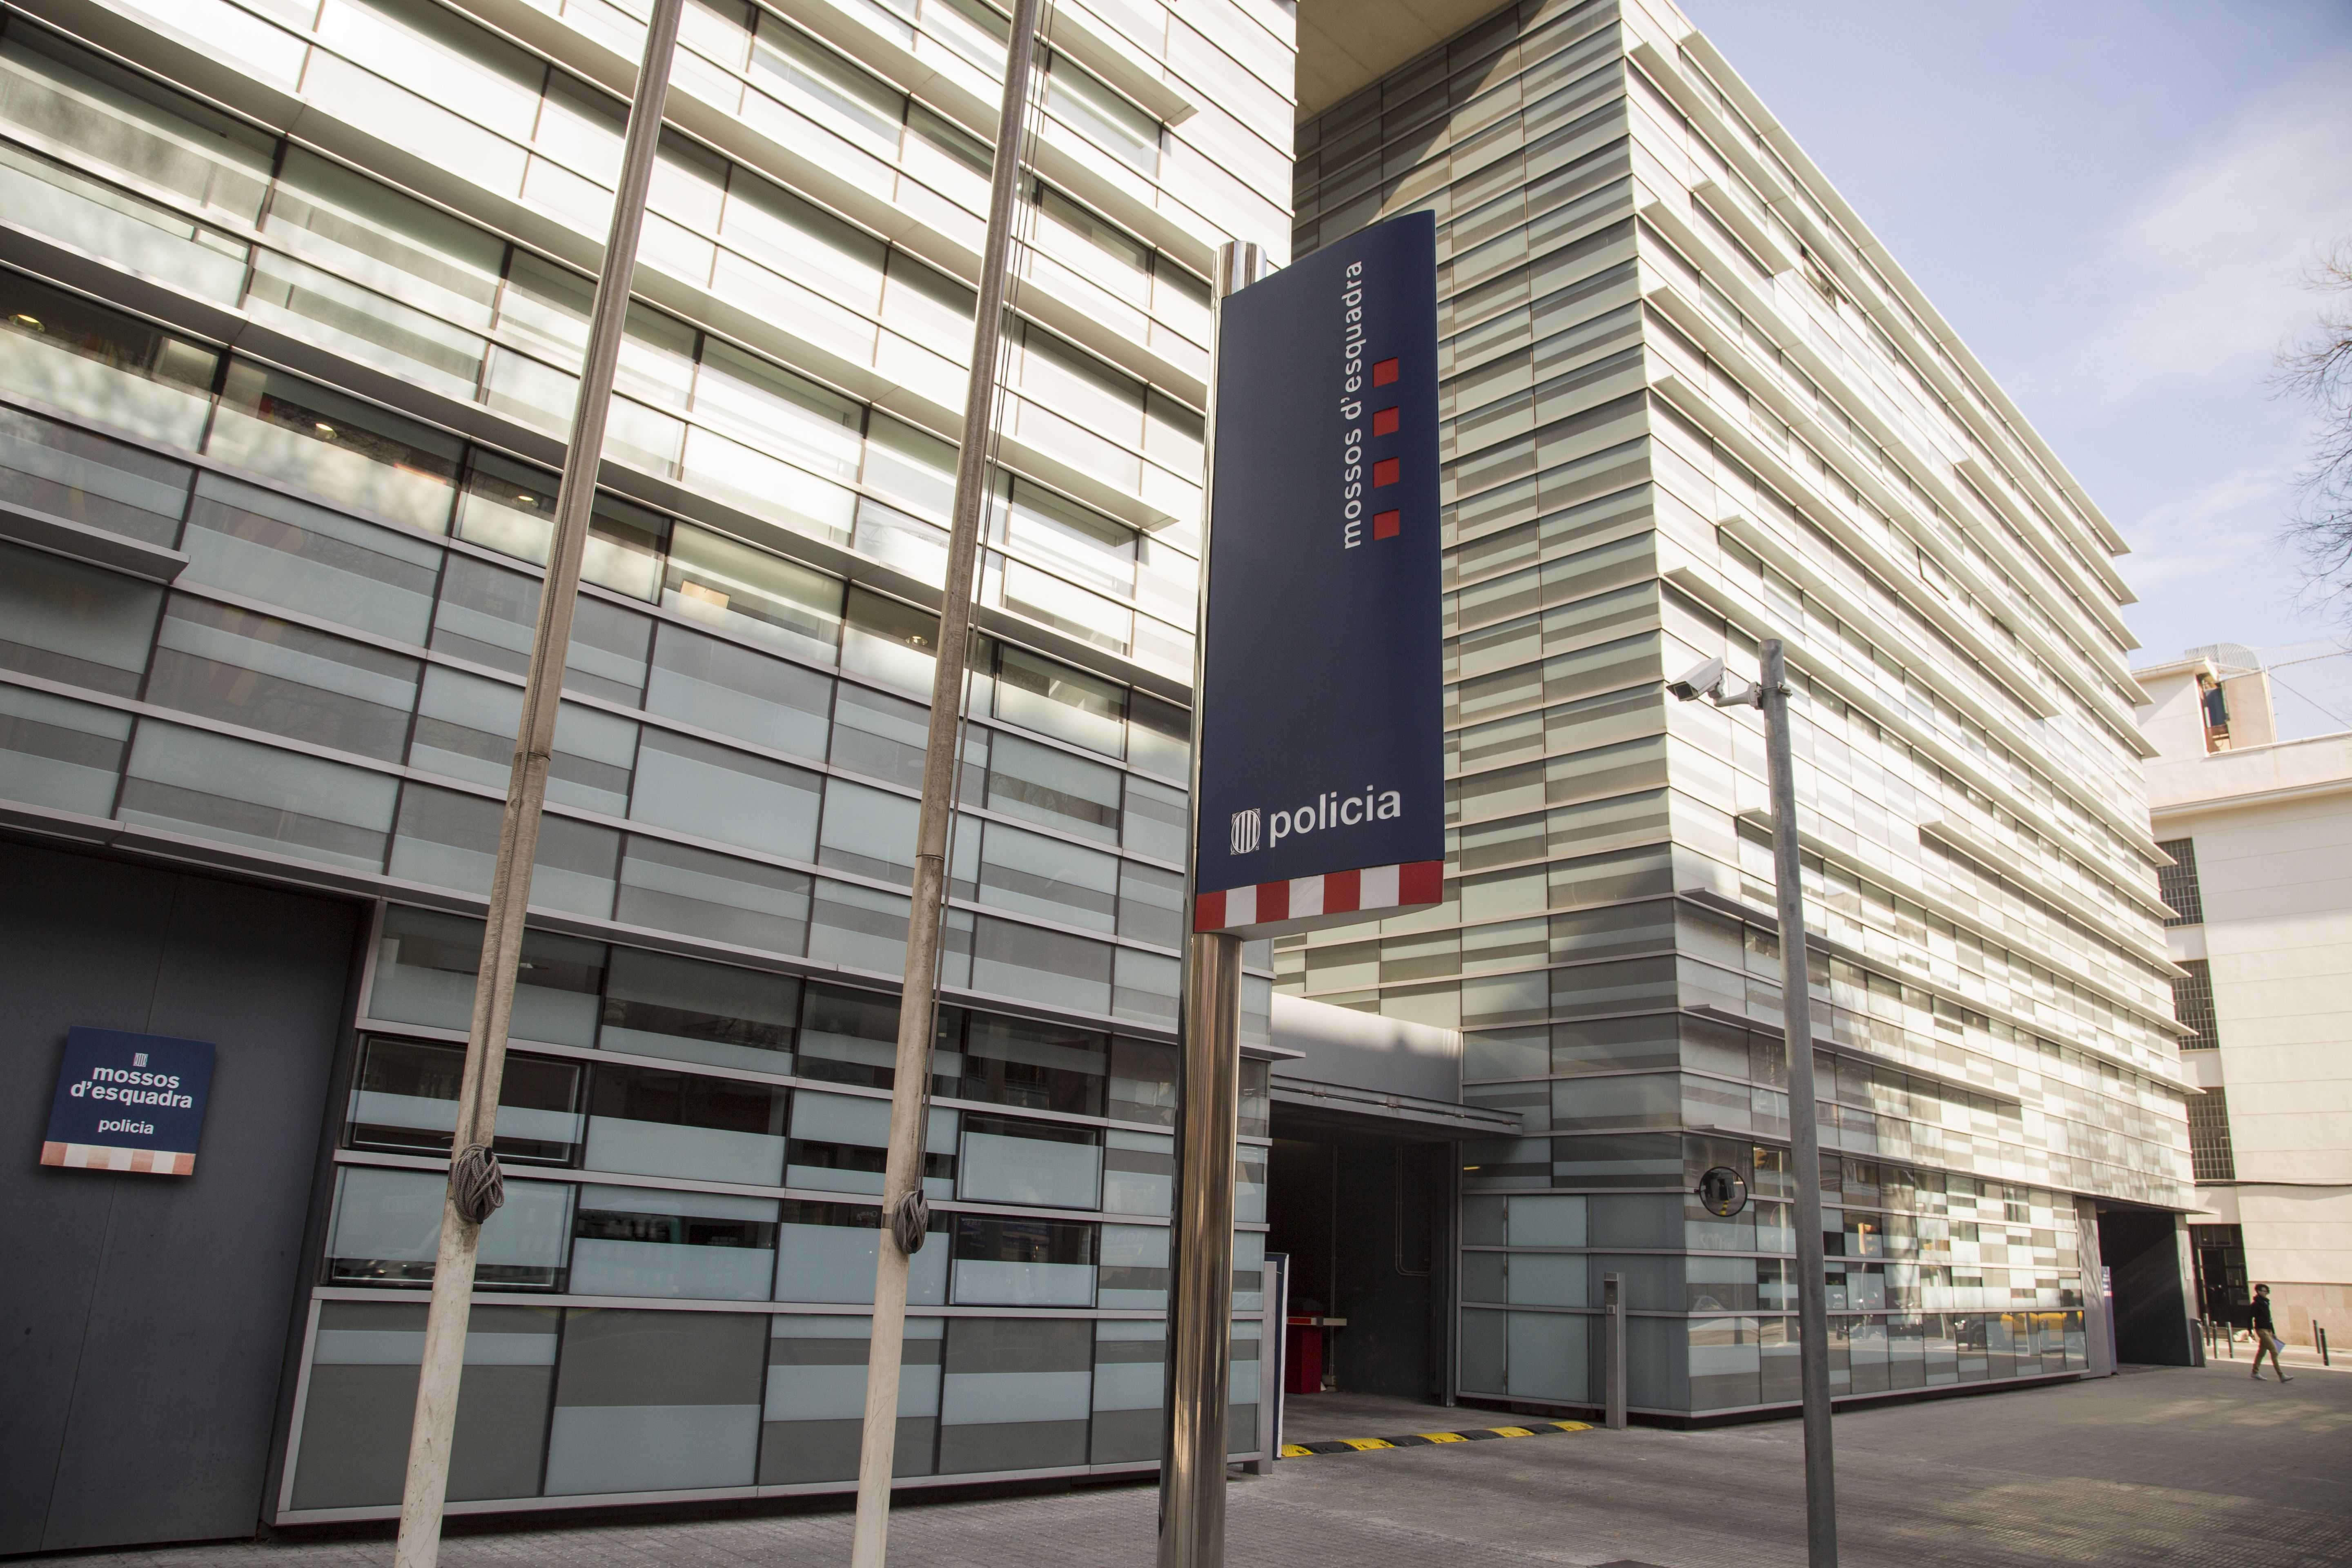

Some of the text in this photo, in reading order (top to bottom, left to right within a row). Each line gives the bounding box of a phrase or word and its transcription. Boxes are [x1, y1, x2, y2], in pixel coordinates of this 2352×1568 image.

[1340, 261, 1366, 550] mossos d'esquadra
[1270, 784, 1401, 848] policia
[92, 1067, 180, 1089] mossos
[70, 1080, 193, 1109] d'esquadra
[98, 1119, 154, 1134] policia
